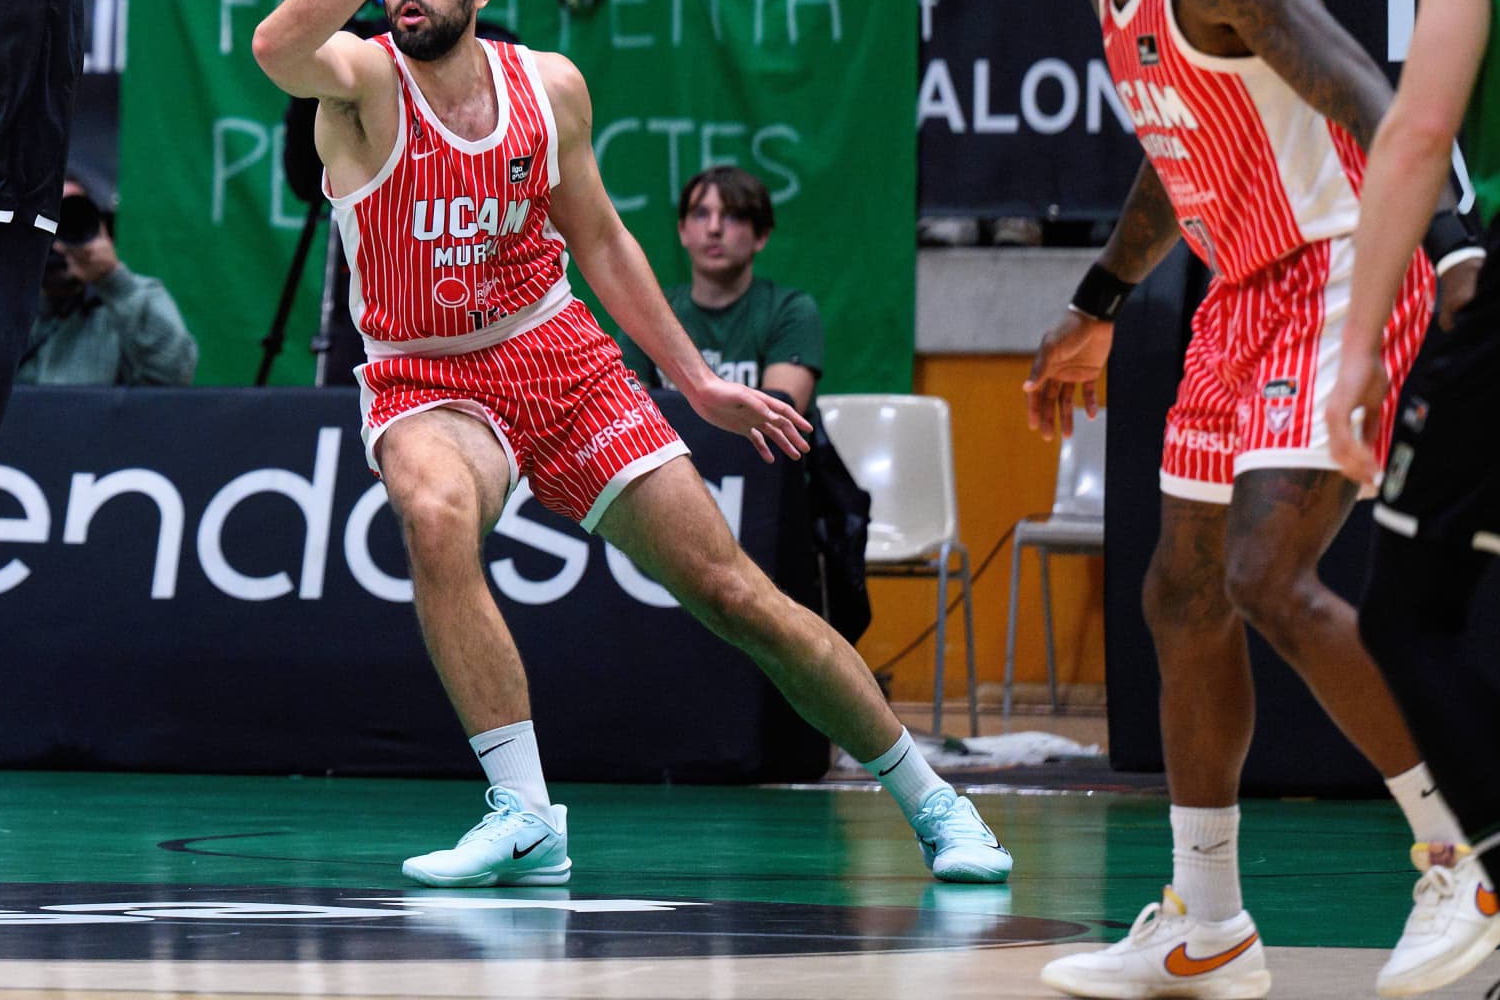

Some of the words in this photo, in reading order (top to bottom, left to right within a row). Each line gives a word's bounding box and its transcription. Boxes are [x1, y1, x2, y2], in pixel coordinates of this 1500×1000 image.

[1118, 79, 1199, 130] CAM
[413, 197, 530, 241] UCAM
[574, 407, 644, 467] INVERSUS
